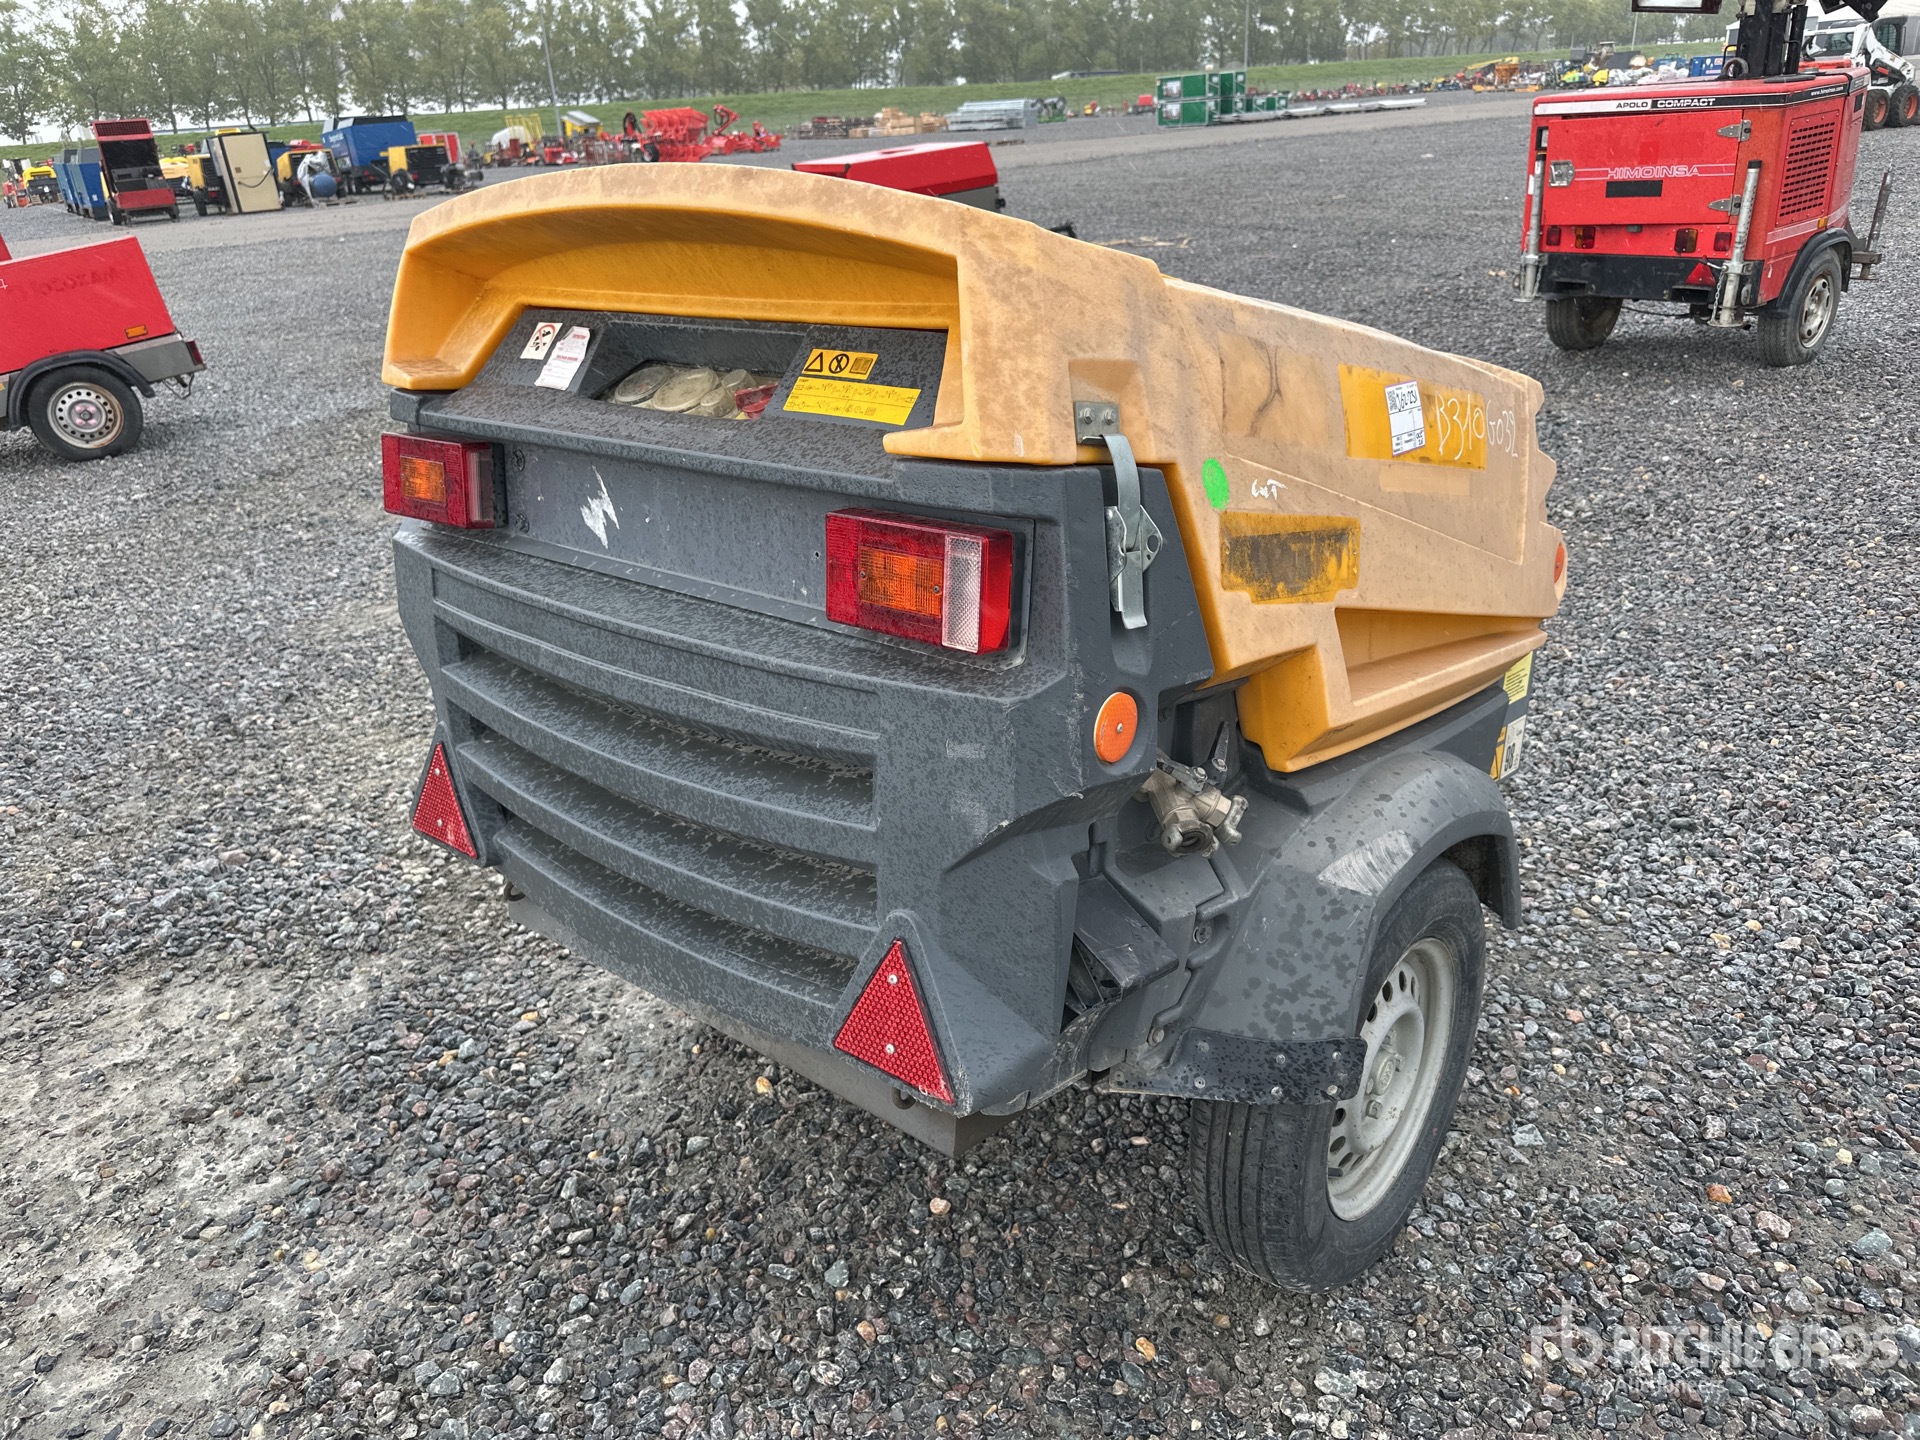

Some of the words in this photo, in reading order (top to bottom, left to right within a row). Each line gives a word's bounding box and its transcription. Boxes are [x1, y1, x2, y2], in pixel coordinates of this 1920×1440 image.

[1615, 101, 1649, 109] APOLO
[1656, 98, 1716, 108] COMPACT
[1607, 164, 1701, 179] HIMOINSA
